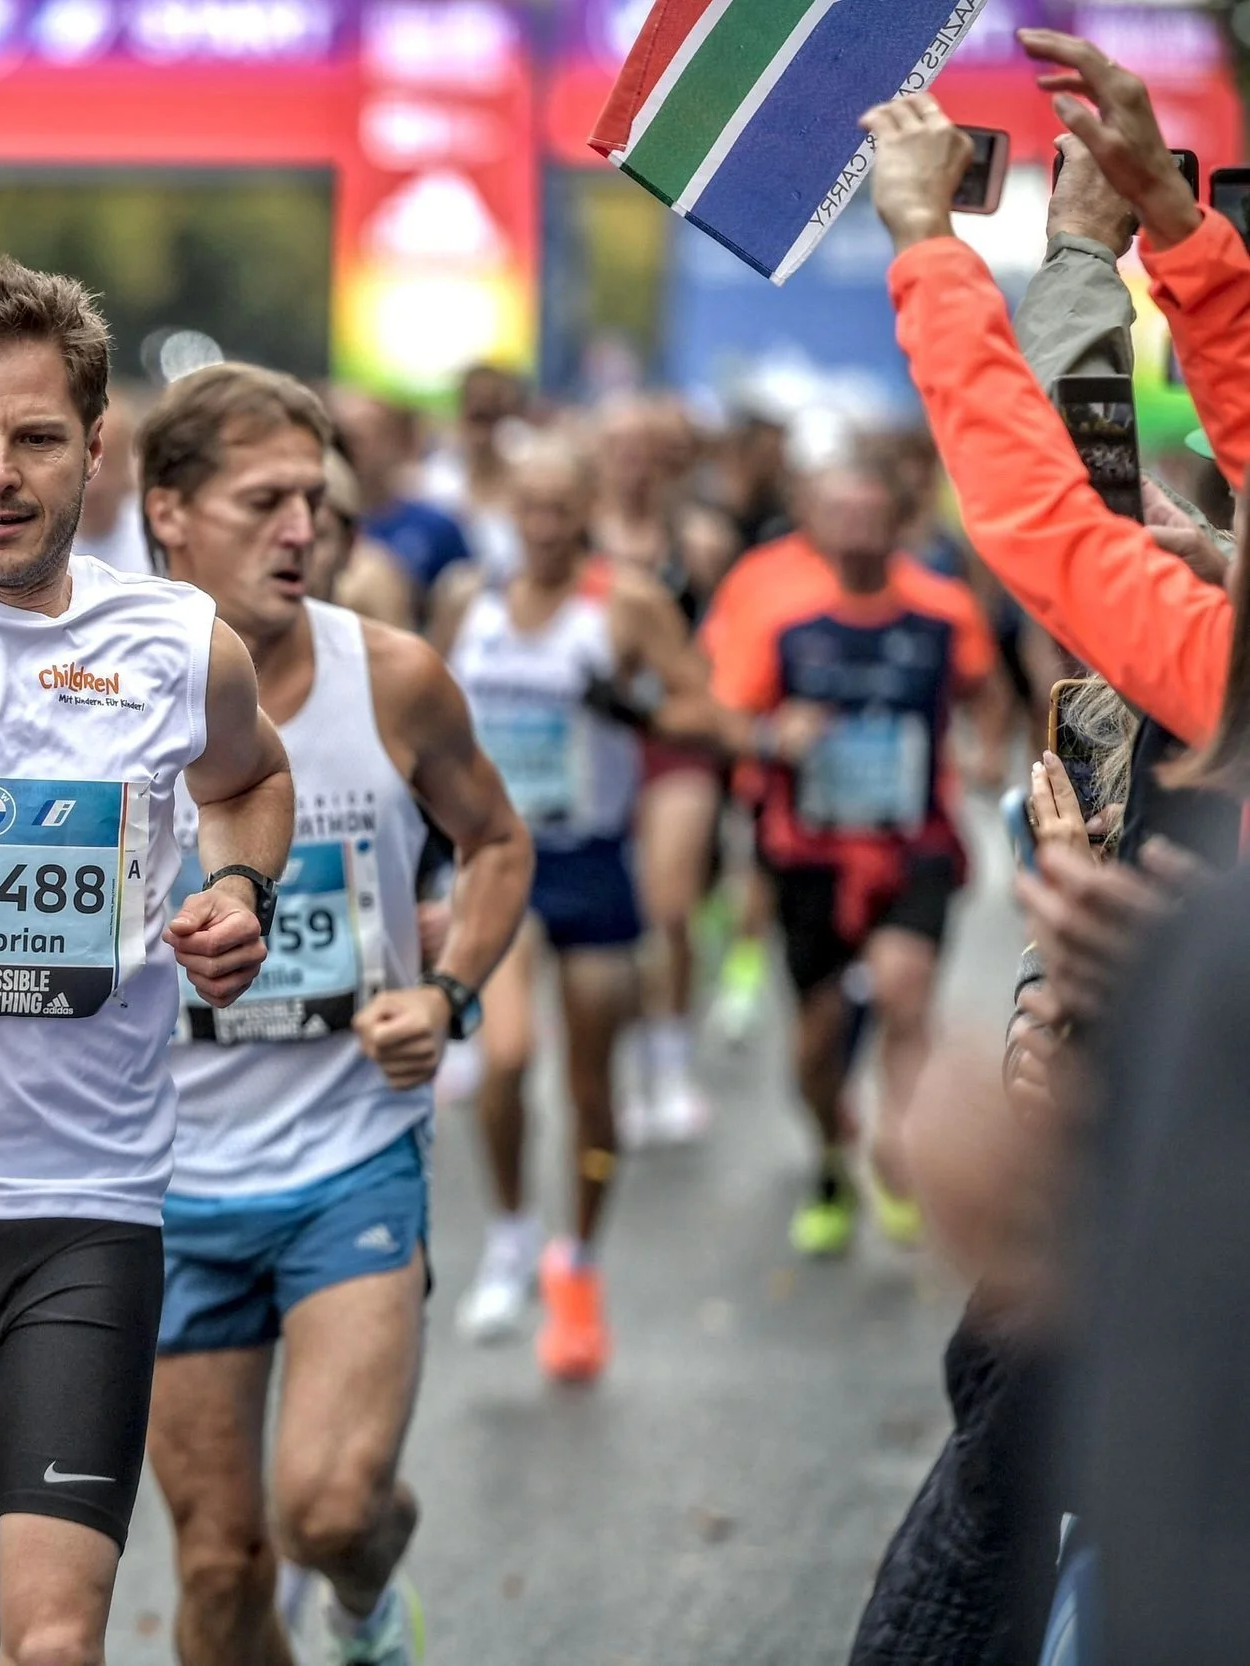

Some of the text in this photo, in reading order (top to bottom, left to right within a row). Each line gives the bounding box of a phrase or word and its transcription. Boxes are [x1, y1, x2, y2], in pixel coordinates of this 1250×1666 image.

[58, 693, 73, 705] Mit
[127, 859, 142, 879] A
[267, 907, 336, 955] 59
[42, 1006, 74, 1015] adidas
